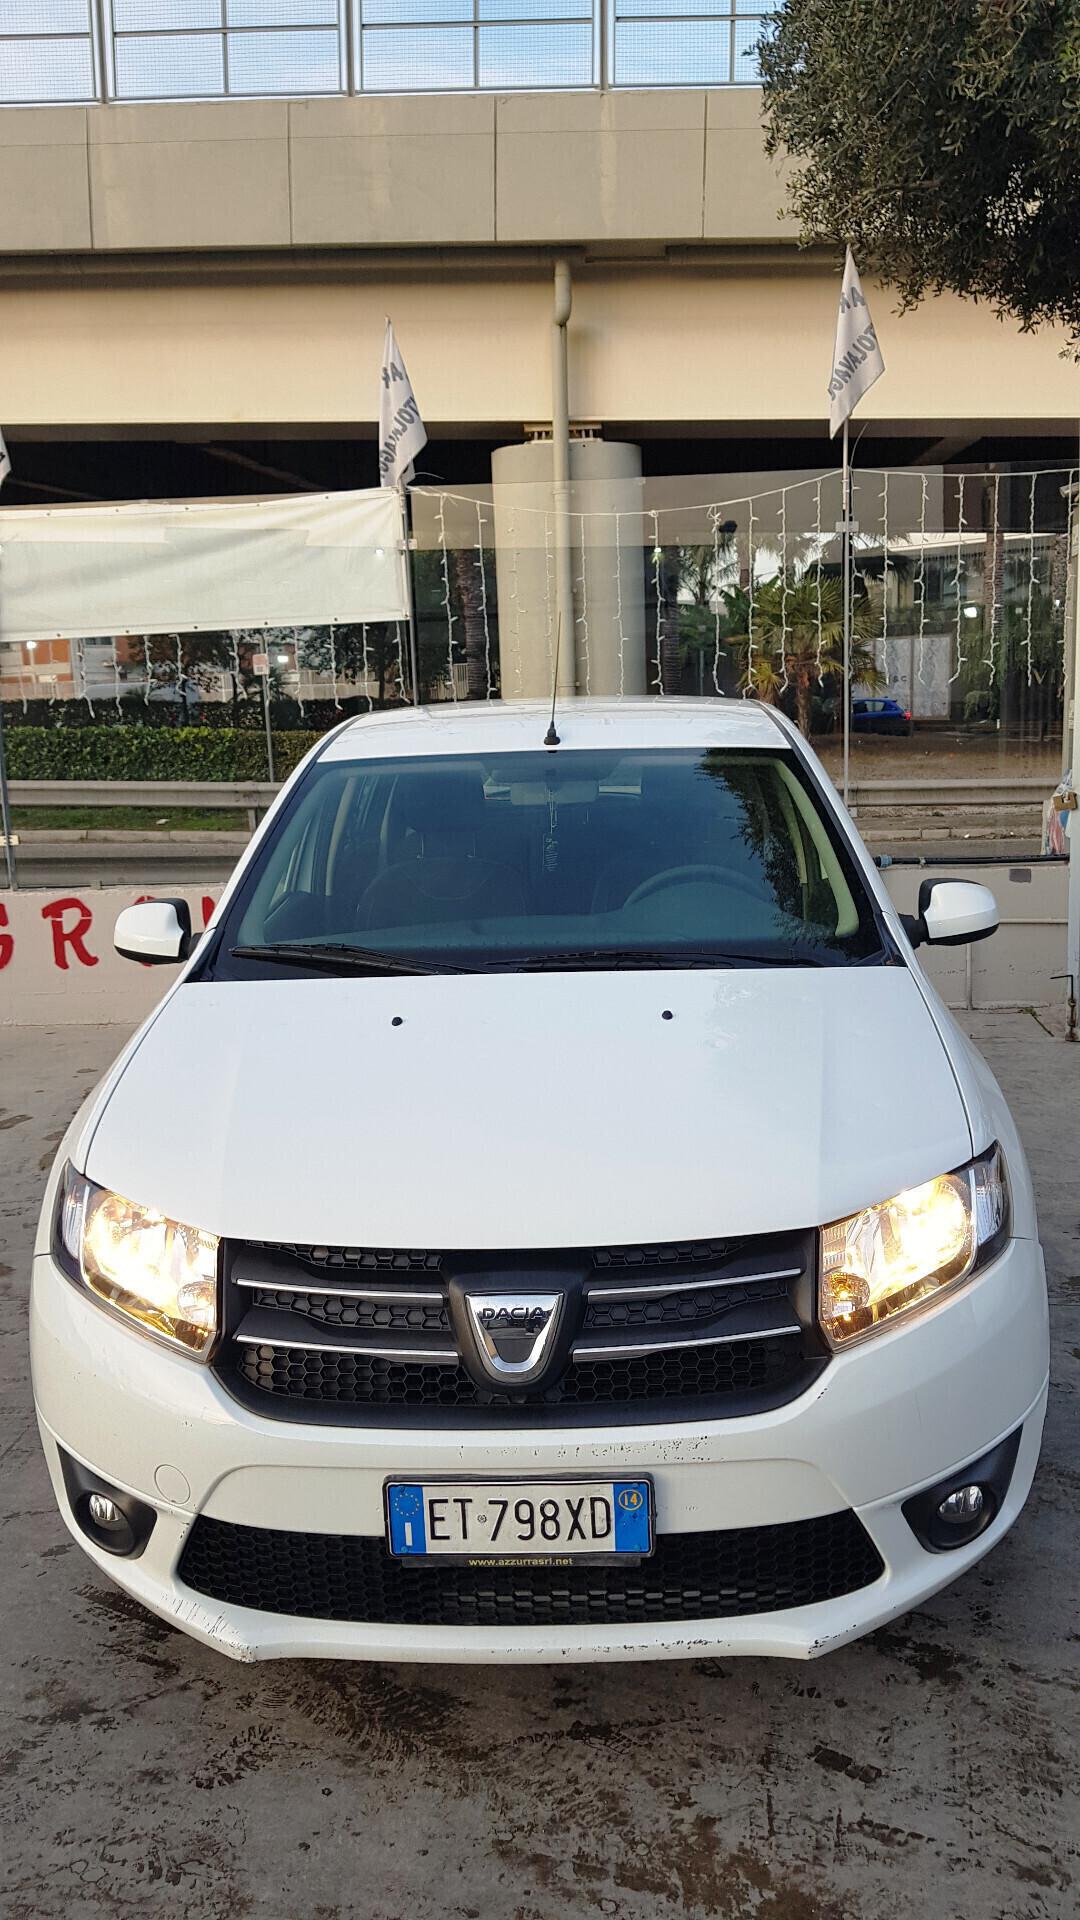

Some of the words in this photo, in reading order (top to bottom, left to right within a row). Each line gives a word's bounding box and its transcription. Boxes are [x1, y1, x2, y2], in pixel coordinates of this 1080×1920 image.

[482, 1307, 546, 1320] DACIA
[624, 1492, 638, 1506] 14
[428, 1498, 473, 1541] ET
[488, 1496, 612, 1541] 798XD
